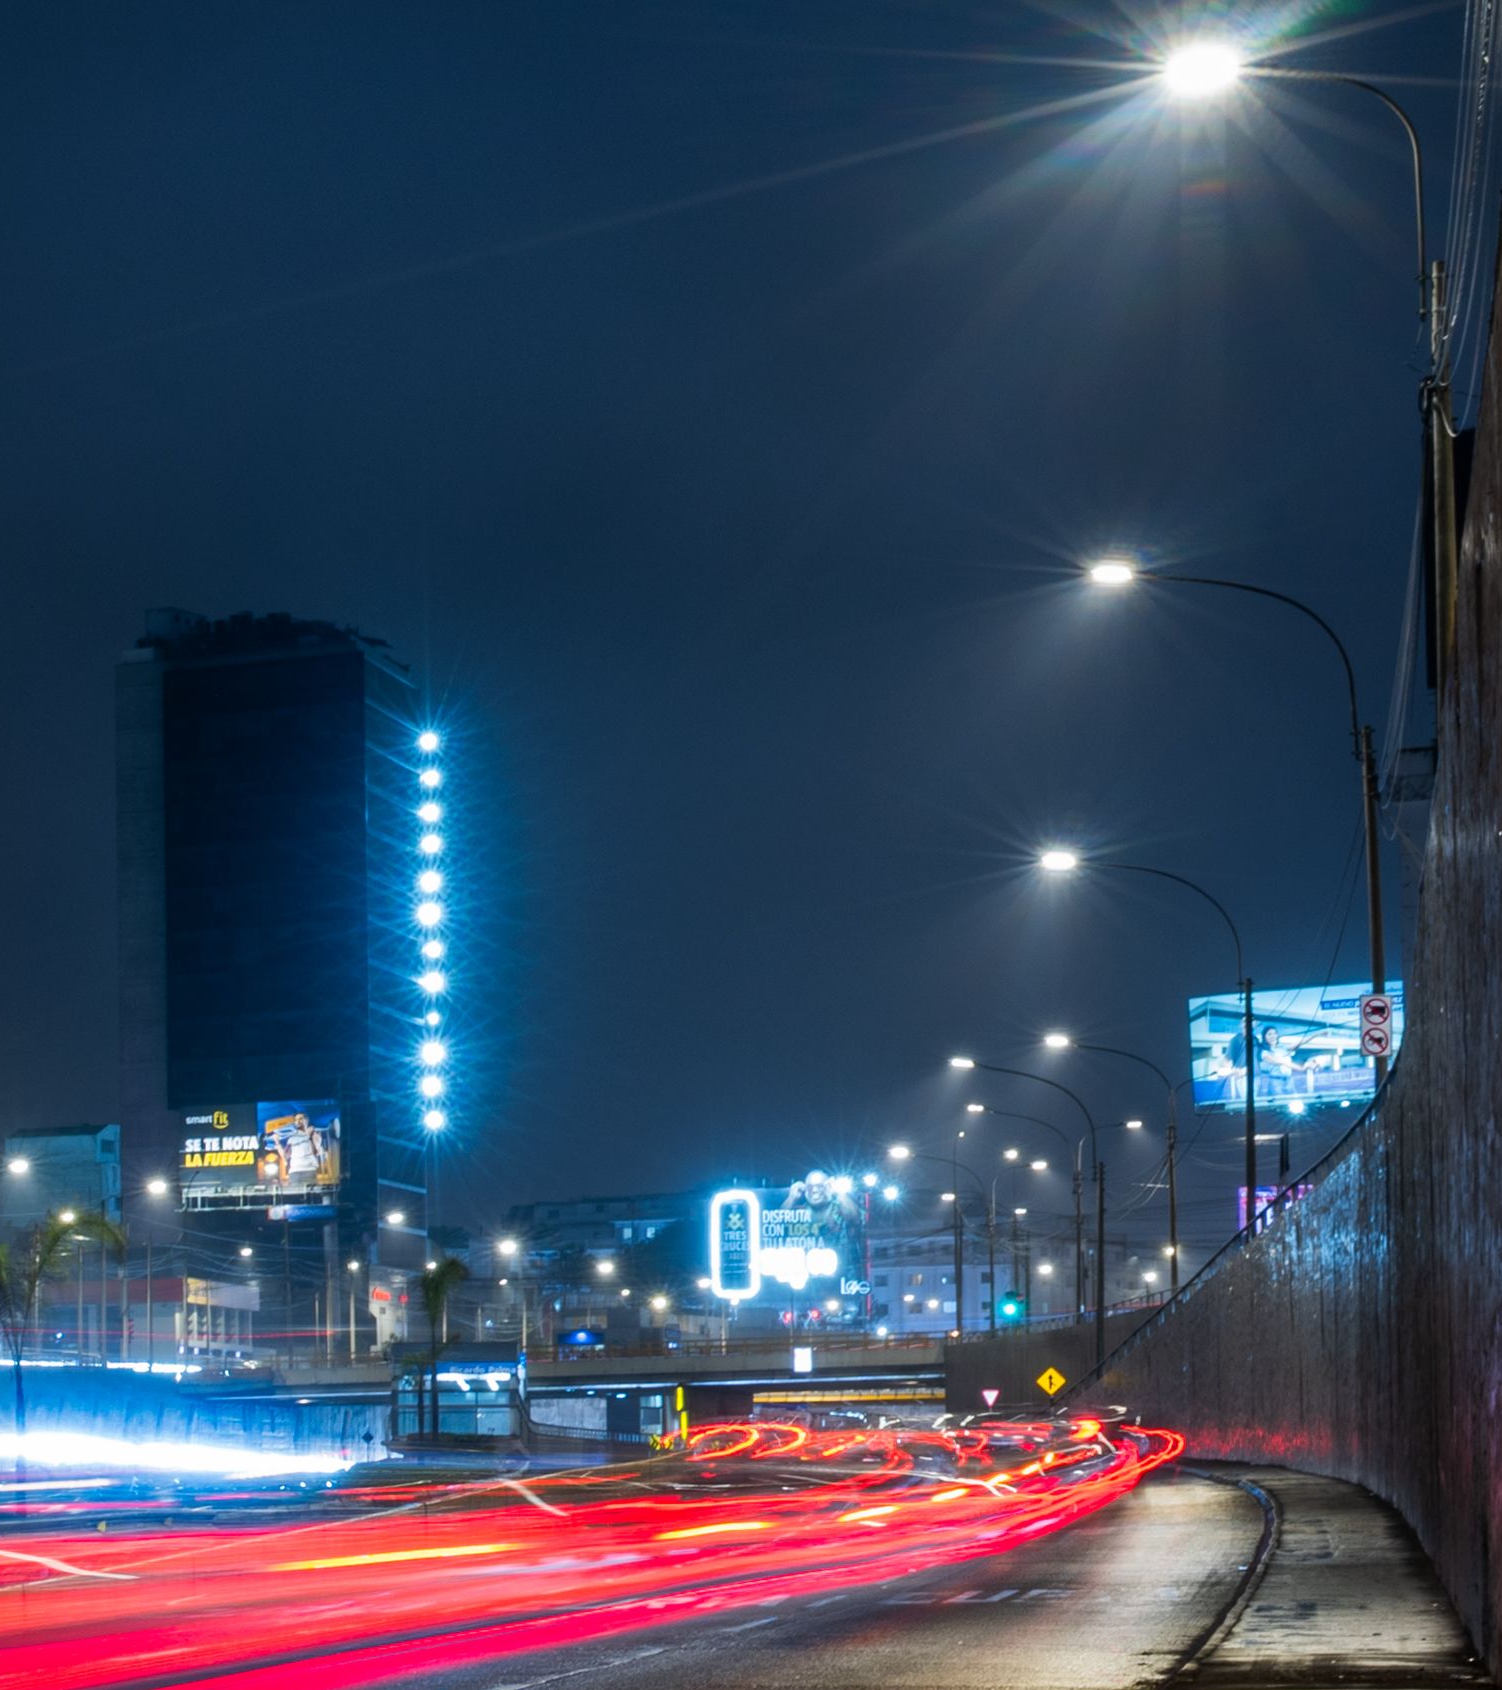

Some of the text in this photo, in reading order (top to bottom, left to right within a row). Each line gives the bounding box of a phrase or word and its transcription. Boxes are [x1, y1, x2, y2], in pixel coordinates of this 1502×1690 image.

[185, 1135, 259, 1153] SE TE NOTA
[185, 1151, 254, 1167] LA FUERZA
[762, 1209, 812, 1223] DISFRUTA
[723, 1231, 747, 1241] TRES
[762, 1225, 785, 1236] CON
[488, 1366, 516, 1375] Palma
